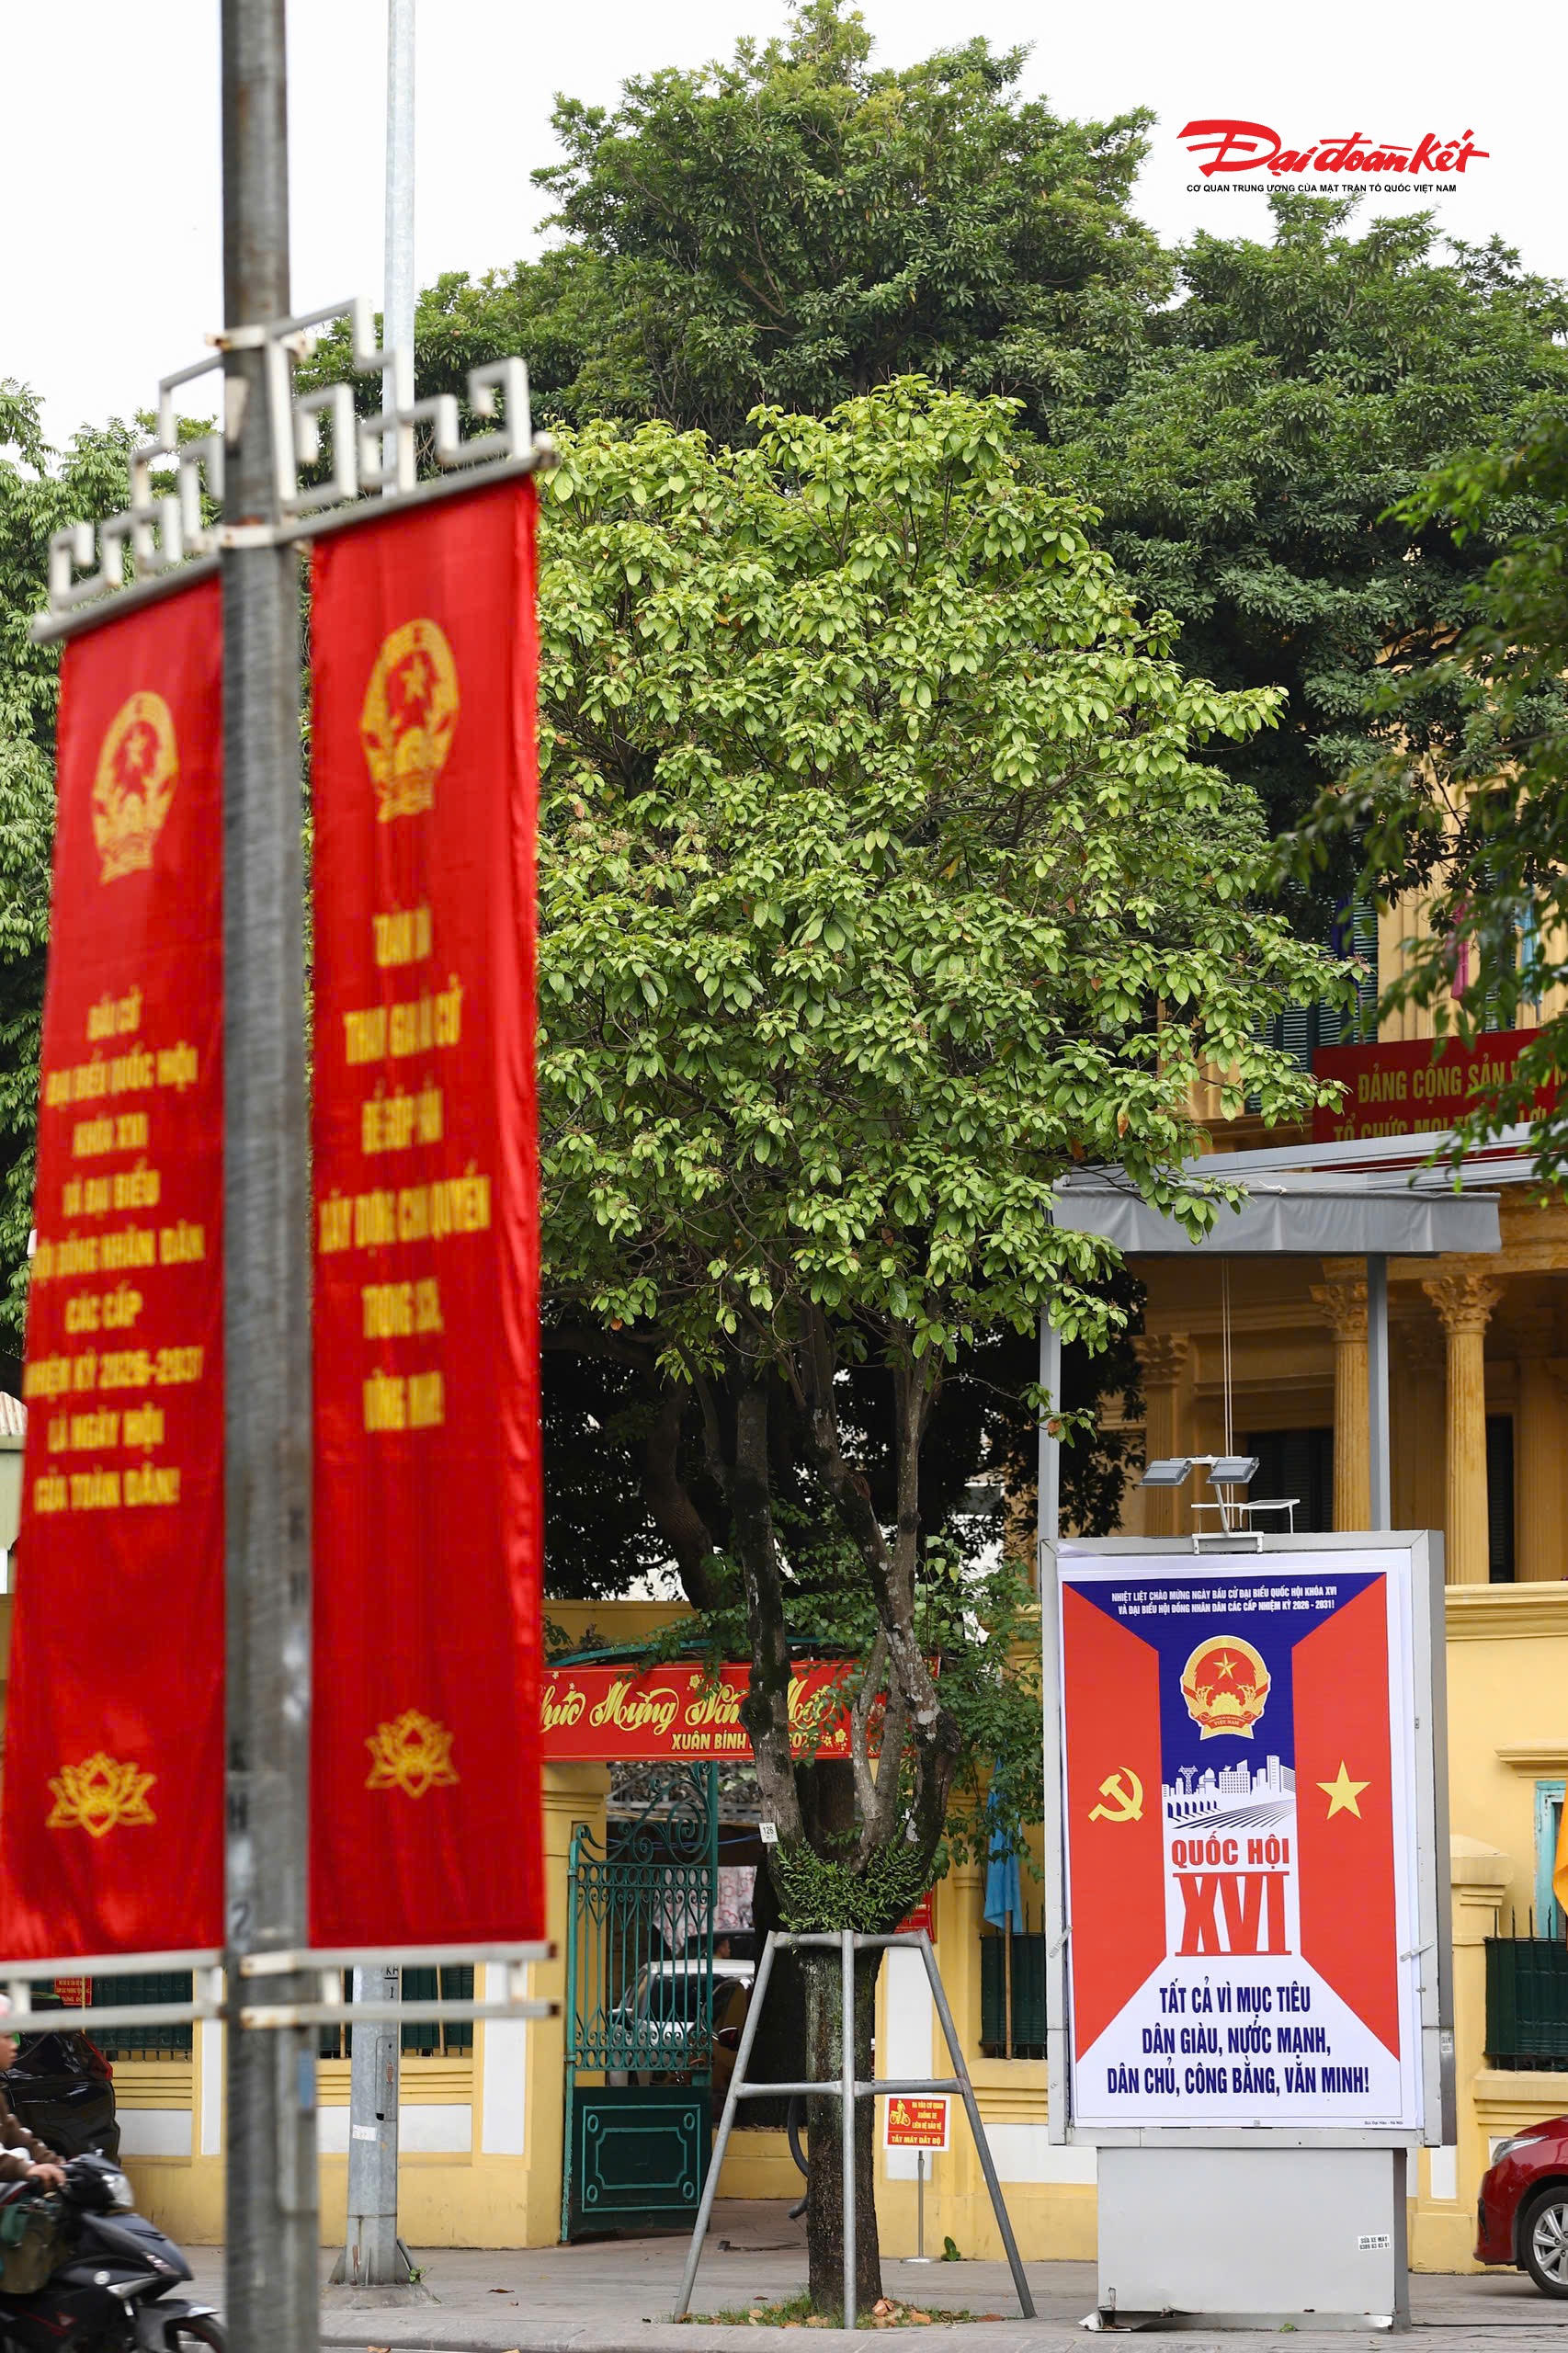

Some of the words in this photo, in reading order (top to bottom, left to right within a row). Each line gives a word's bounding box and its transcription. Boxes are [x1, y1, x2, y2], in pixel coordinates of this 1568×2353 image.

[1358, 1063, 1406, 1103] ĐẢNG
[1413, 1063, 1461, 1105] CỘNG
[1468, 1052, 1506, 1089] SẢN
[1111, 1591, 1131, 1603] NHIỆT
[1133, 1590, 1147, 1603] LIỆT
[1149, 1589, 1167, 1600] CHÀO
[1169, 1588, 1190, 1599] MỪNG
[1192, 1588, 1210, 1599] NGÀY
[1211, 1586, 1226, 1598] BẦU
[1228, 1586, 1238, 1598] CỬ
[1253, 1585, 1268, 1597] BIỂU
[1270, 1585, 1289, 1597] QUỐC
[1290, 1586, 1302, 1598] HỘI
[1304, 1585, 1324, 1596] KHÓA
[1325, 1586, 1336, 1596] XVI
[1118, 1604, 1127, 1615] VÀ
[1142, 1601, 1157, 1614] BIỂU
[1158, 1603, 1170, 1615] HỘI
[1171, 1601, 1189, 1613] ĐỒNG
[1191, 1602, 1210, 1613] NHÂN
[1212, 1601, 1226, 1612] DÂN
[1228, 1600, 1241, 1611] CÁC
[1243, 1599, 1256, 1611] CẤP
[1258, 1599, 1280, 1612] NHIỆM
[1282, 1599, 1291, 1609] KỲ
[1292, 1600, 1309, 1609] 2026
[589, 1680, 679, 1735] Mừng
[671, 1731, 710, 1750] XUÂN
[714, 1729, 746, 1749] BÍNH
[1172, 1831, 1238, 1868] QUỐC
[1247, 1834, 1289, 1869] HỘI
[1173, 1871, 1291, 1956] XVI
[1159, 1978, 1186, 2013] TẤT
[1191, 1975, 1212, 2013] CẢ
[1217, 1981, 1232, 2012] VÌ
[1237, 1986, 1271, 2018] MỤC
[1277, 1981, 1310, 2012] TIÊU
[1142, 2022, 1175, 2053] DÂN
[1180, 2022, 1222, 2056] GIÀU,
[1228, 2019, 1271, 2053] NƯỚC
[1277, 2027, 1330, 2059] MẠNH,
[1108, 2063, 1139, 2093] DÂN
[1144, 2056, 1179, 2097] CHỦ,
[1185, 2062, 1227, 2094] CÔNG
[1233, 2055, 1279, 2097] BẰNG,
[1284, 2061, 1316, 2092] VĂN
[1322, 2066, 1369, 2092] MINH!
